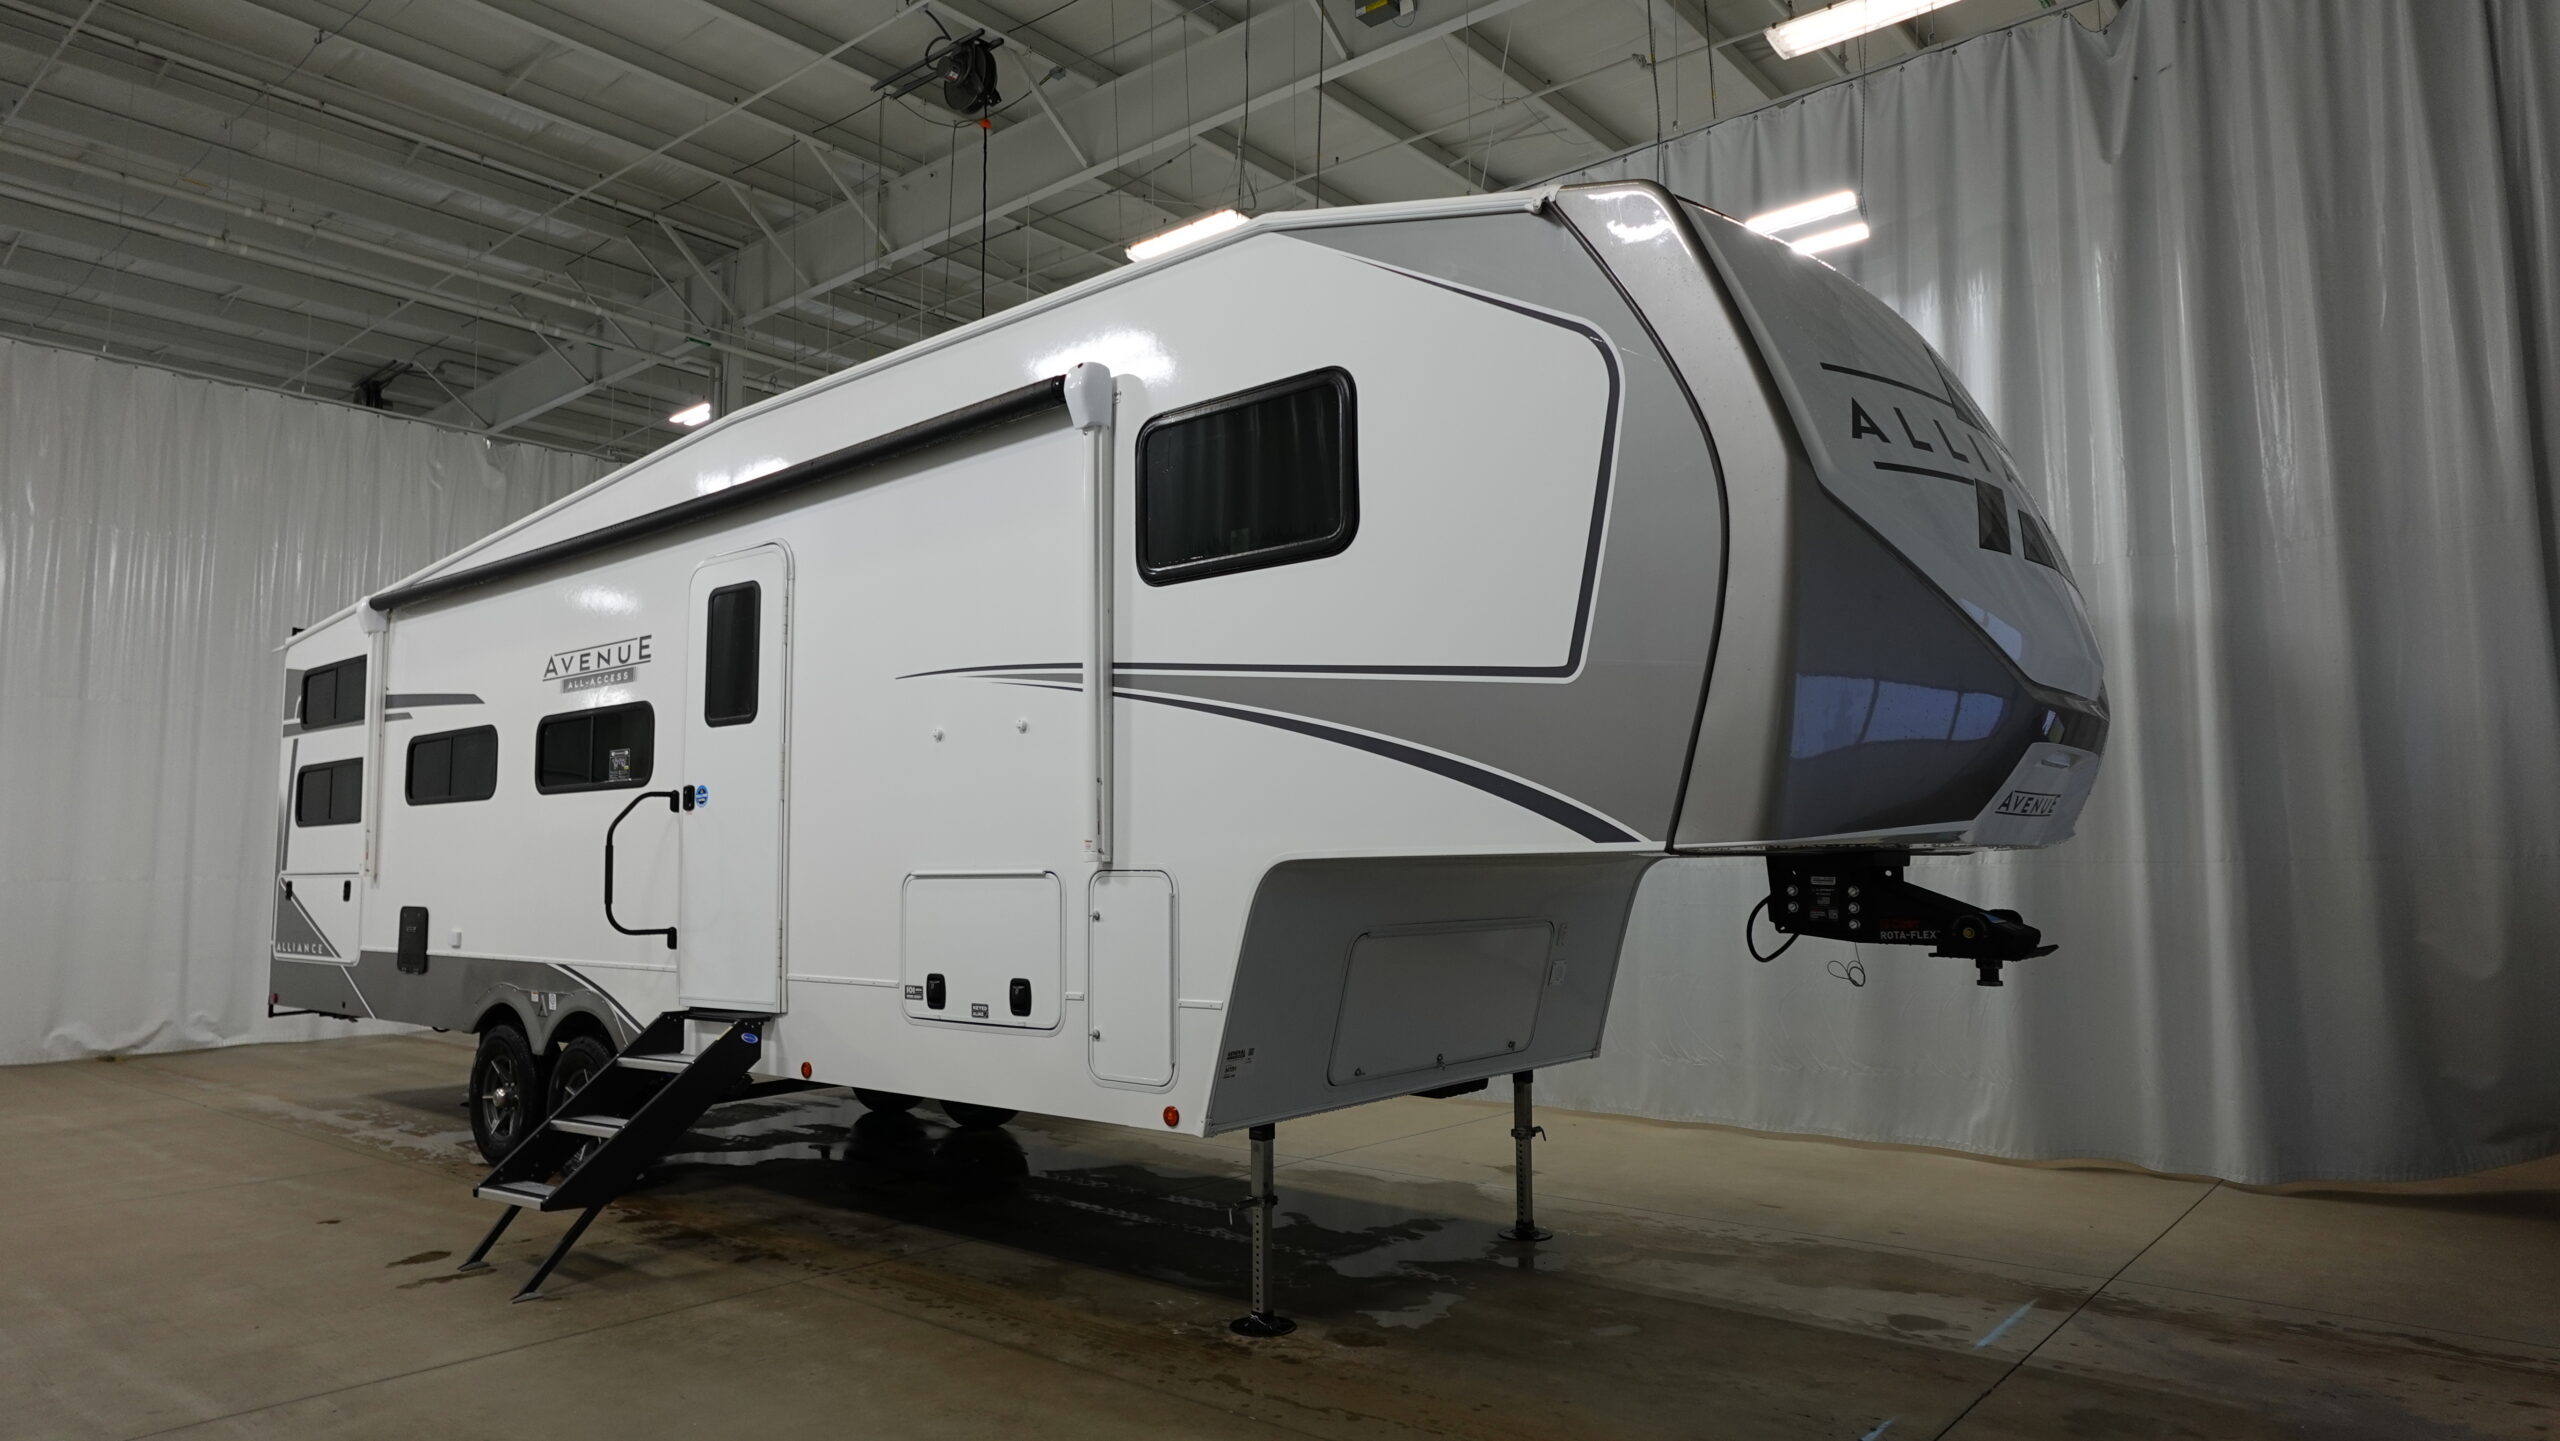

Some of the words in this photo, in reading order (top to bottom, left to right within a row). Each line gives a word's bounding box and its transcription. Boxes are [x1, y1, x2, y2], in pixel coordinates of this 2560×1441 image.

[1851, 397, 2012, 481] ALLI
[543, 634, 652, 678] AVENUE
[568, 672, 629, 689] ALL-ACCESS
[1997, 791, 2061, 814] AVENUE
[1880, 930, 1937, 940] ROTA-FLEX
[276, 942, 323, 954] ALLIANCE
